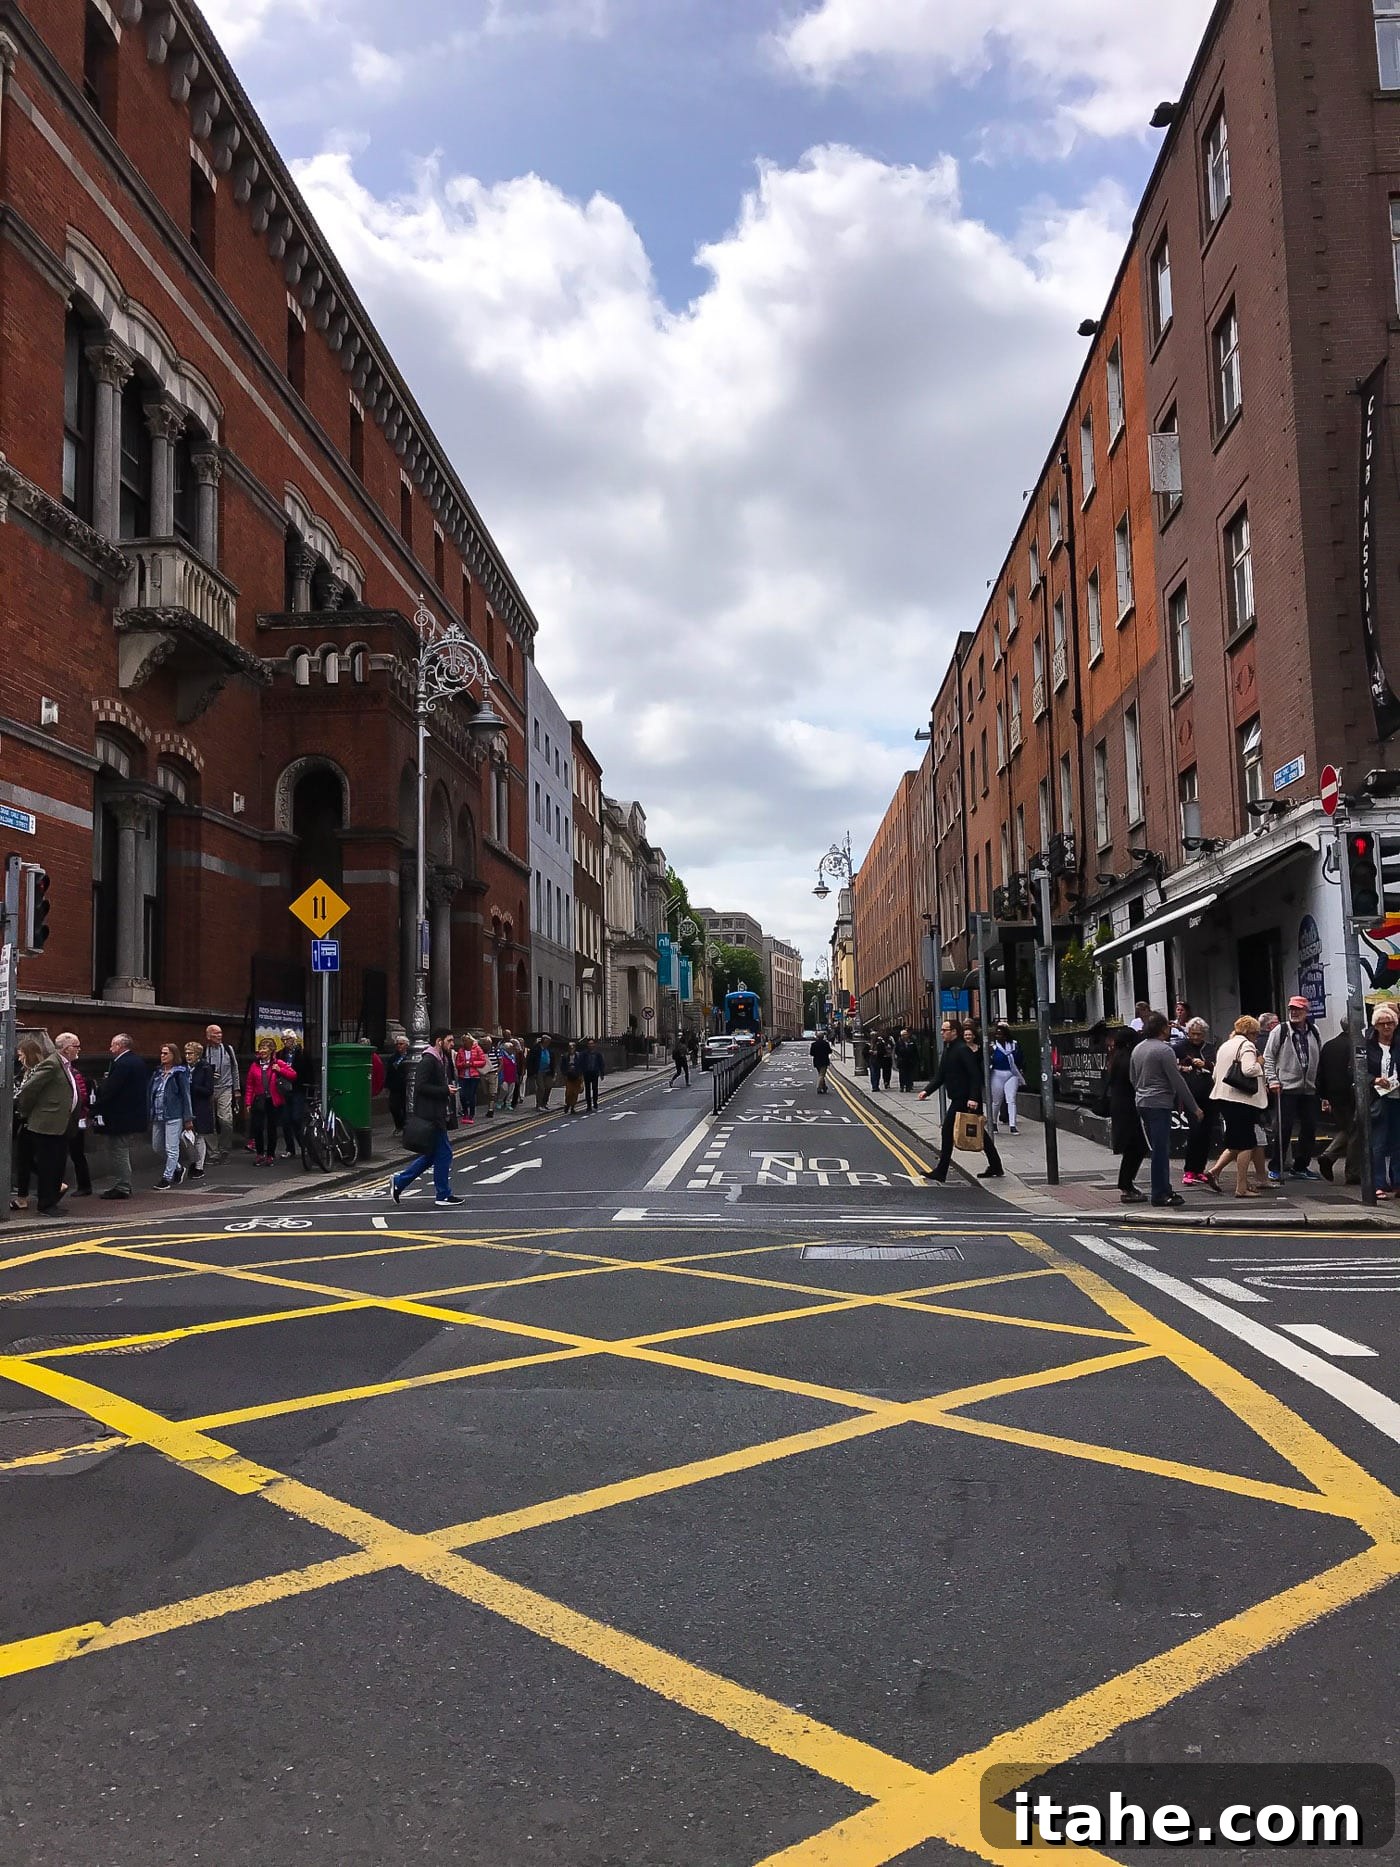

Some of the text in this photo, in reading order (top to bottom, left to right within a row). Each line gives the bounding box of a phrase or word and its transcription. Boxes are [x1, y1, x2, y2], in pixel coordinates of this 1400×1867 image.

[1364, 395, 1375, 485] CLUB
[760, 1155, 850, 1171] NO
[709, 1171, 930, 1187] ENTRY
